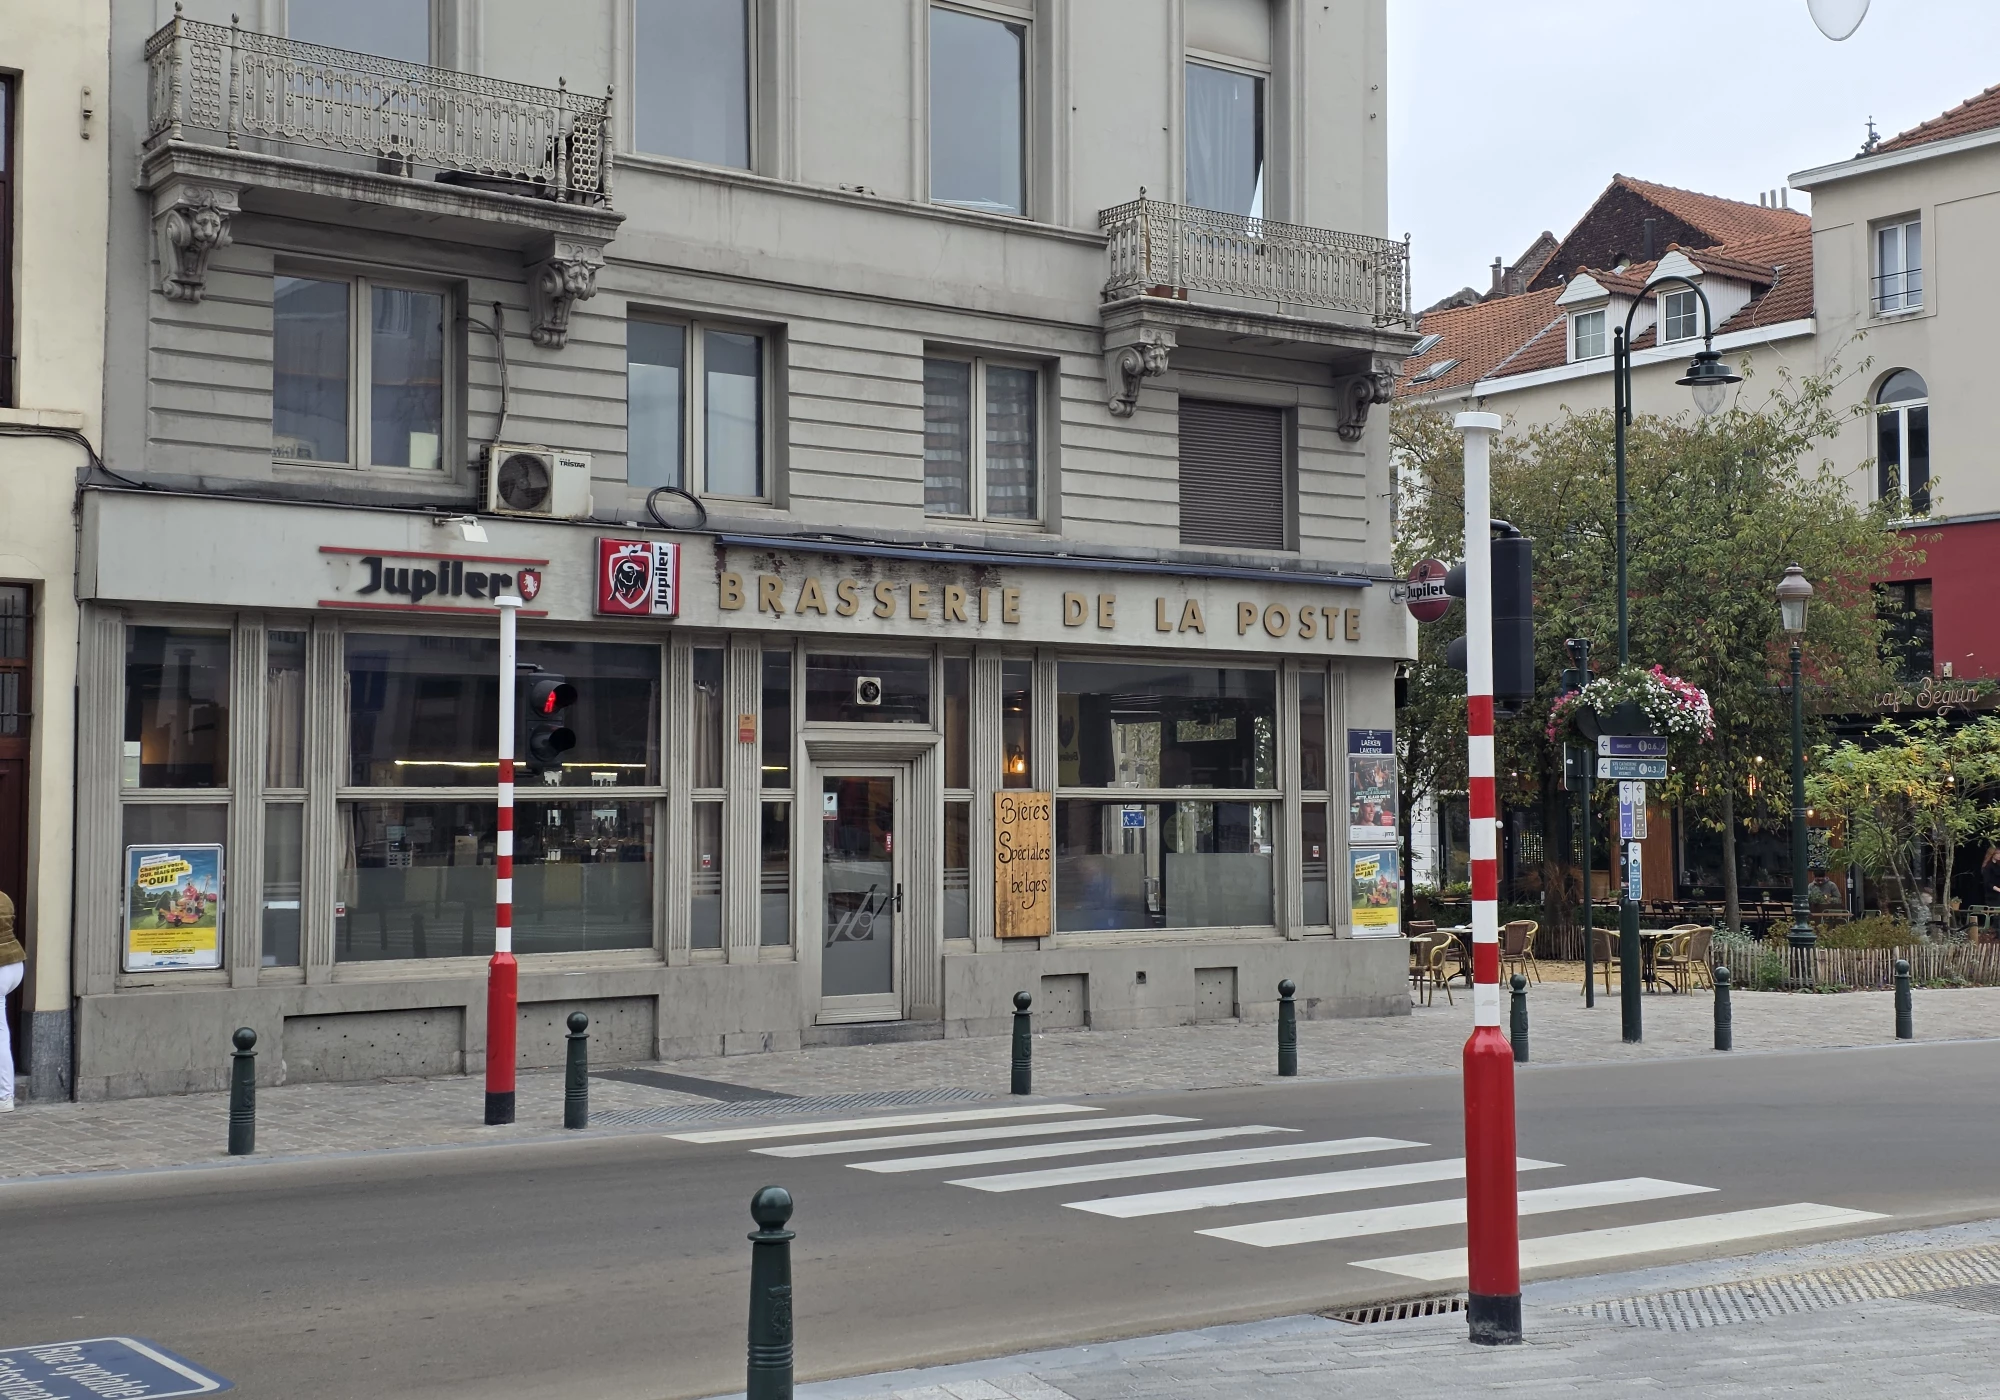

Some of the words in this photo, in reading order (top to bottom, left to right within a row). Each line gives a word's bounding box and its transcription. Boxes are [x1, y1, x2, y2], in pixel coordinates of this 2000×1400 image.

[559, 460, 586, 469] TRISTAR
[356, 556, 513, 604] Jupiler
[653, 545, 670, 611] Jupiler
[1407, 583, 1446, 600] Jupiler
[719, 571, 1021, 624] BRASSERIE
[1063, 591, 1117, 629] DE
[1156, 596, 1206, 634] LA
[1237, 601, 1361, 641] POSTE
[1000, 797, 1050, 825] Bières
[998, 830, 1050, 872] Spéciales
[1011, 871, 1048, 910] belges
[28, 1345, 86, 1365] Rue
[48, 1363, 151, 1399] cyclable
